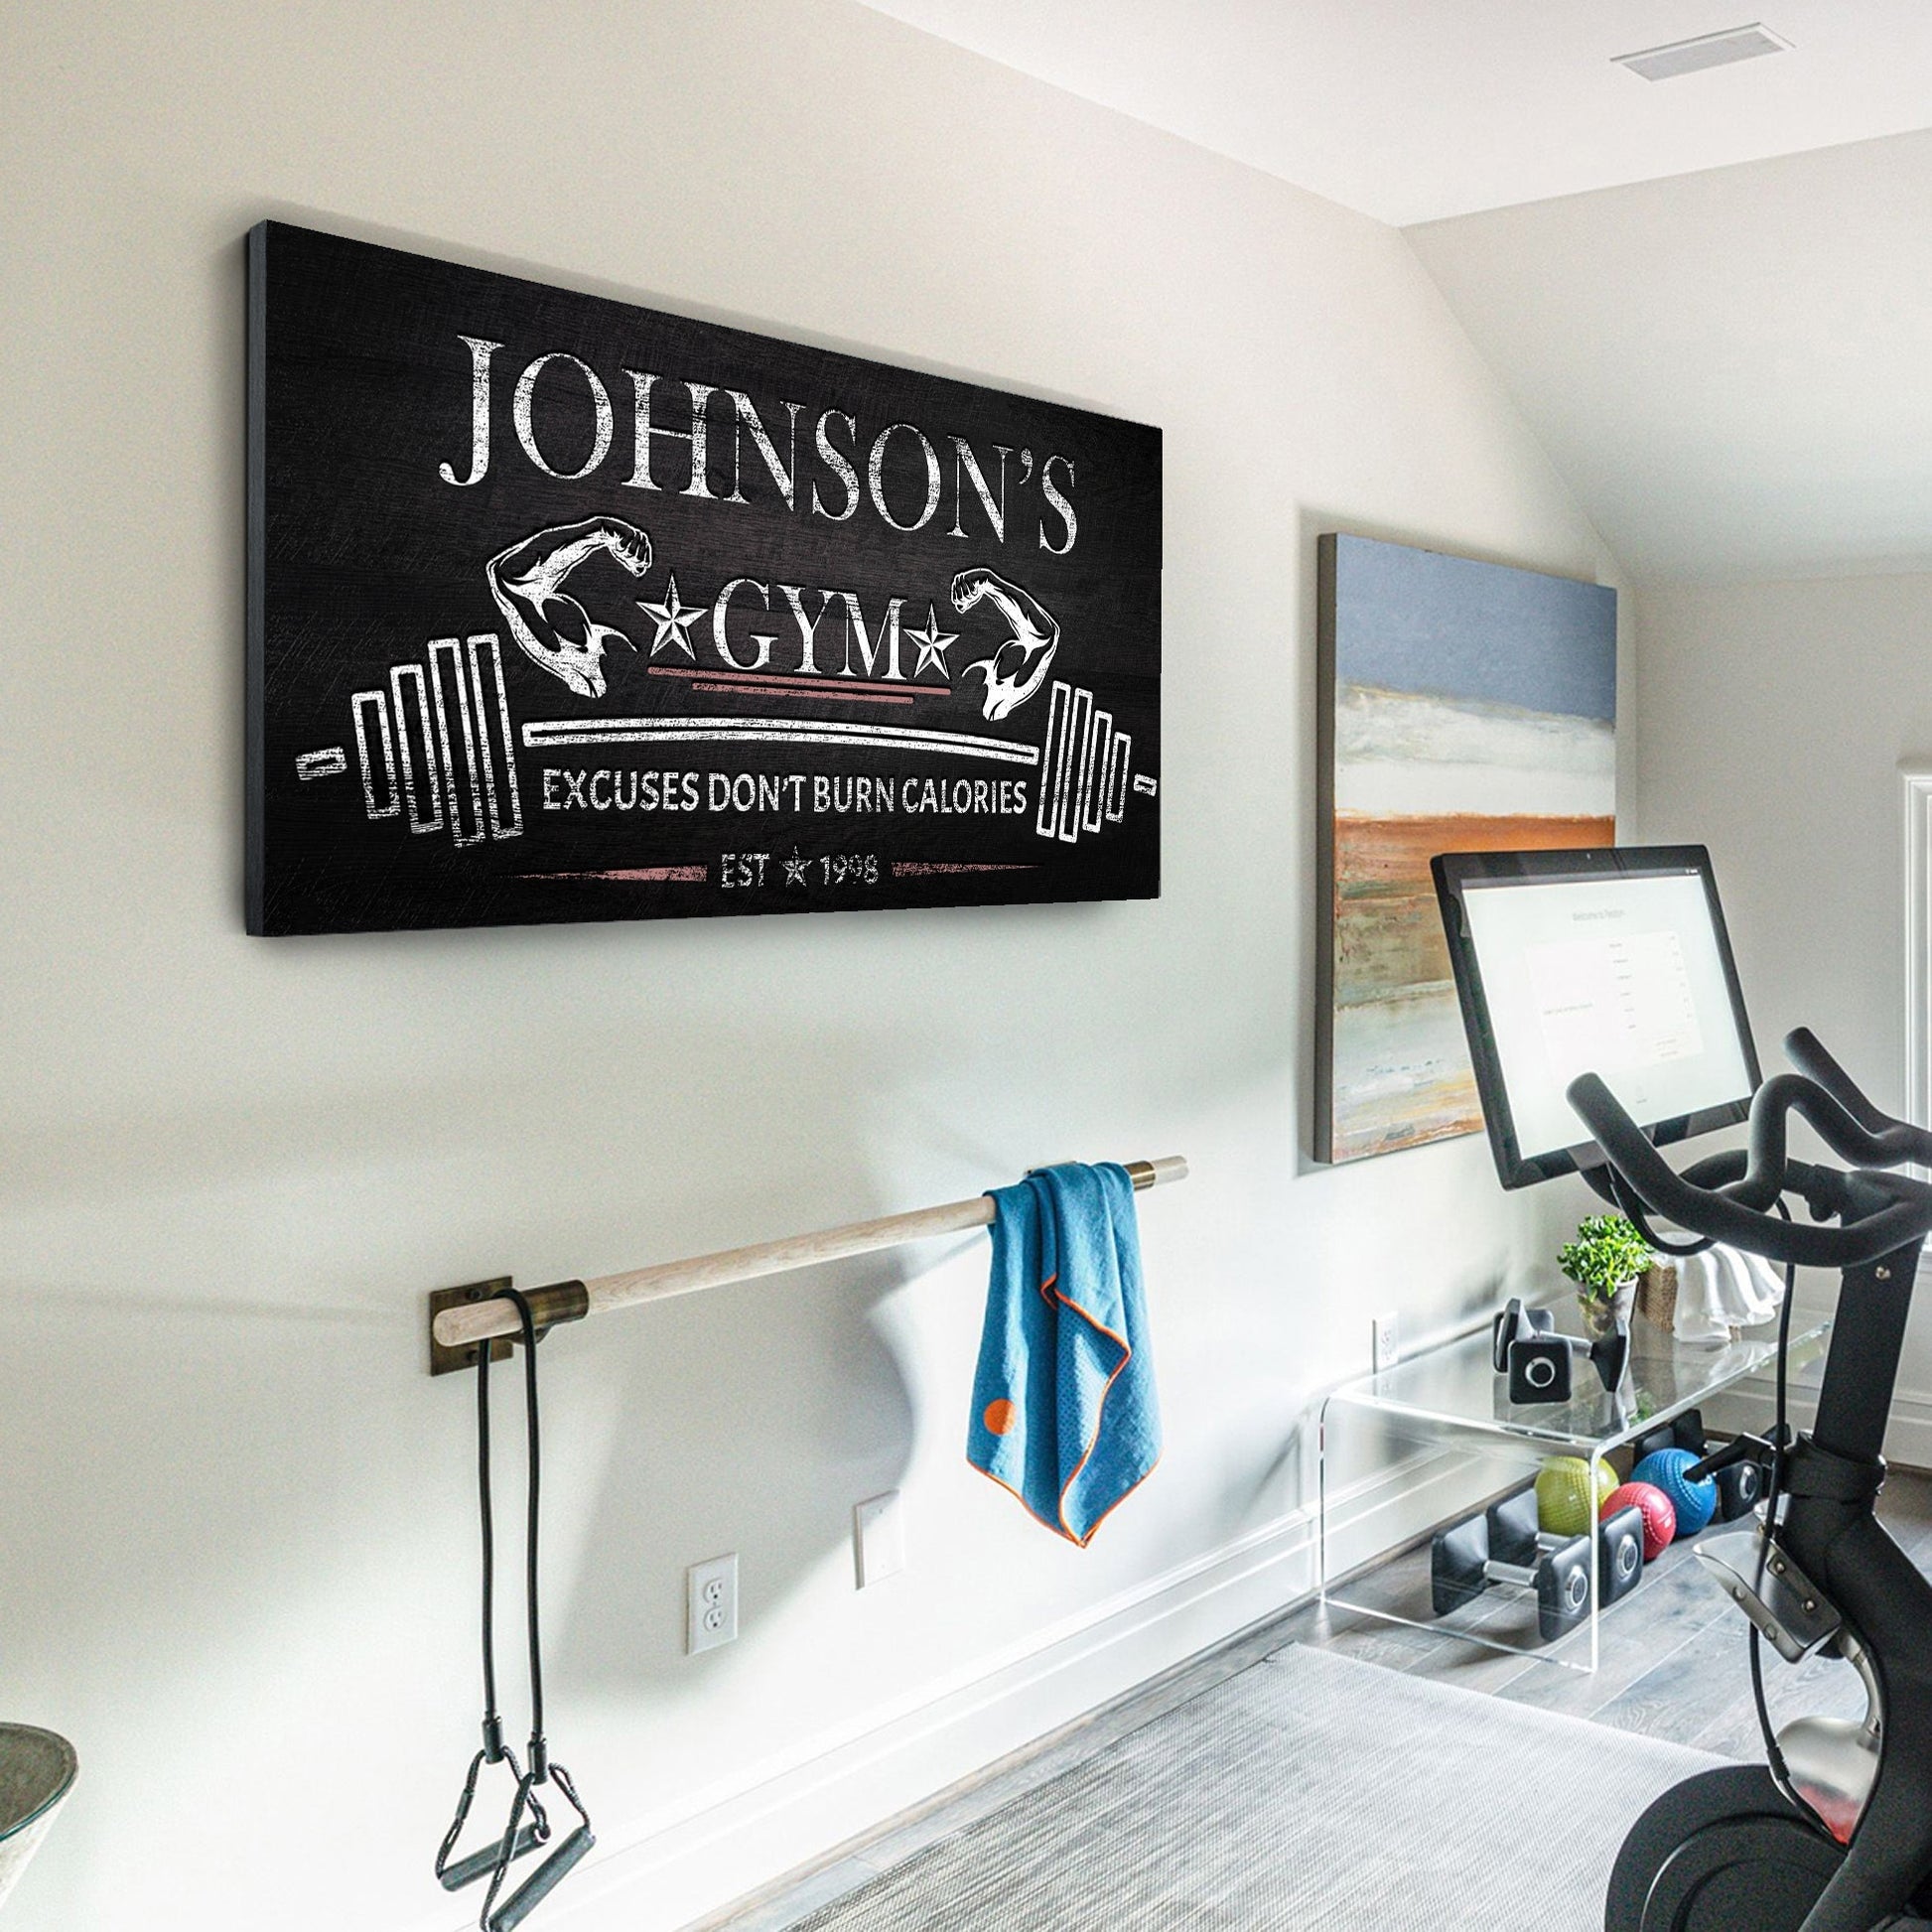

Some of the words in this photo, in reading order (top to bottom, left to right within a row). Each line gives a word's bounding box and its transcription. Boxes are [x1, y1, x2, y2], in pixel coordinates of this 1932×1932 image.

[439, 336, 1077, 554] JOHNSON'S
[713, 579, 907, 680] GYM
[543, 769, 699, 811] EXCUSES
[709, 773, 806, 811] DON'T
[814, 776, 894, 812] BURN
[902, 778, 1027, 814] CALORIES
[722, 854, 769, 888] EST
[820, 855, 878, 885] 1998
